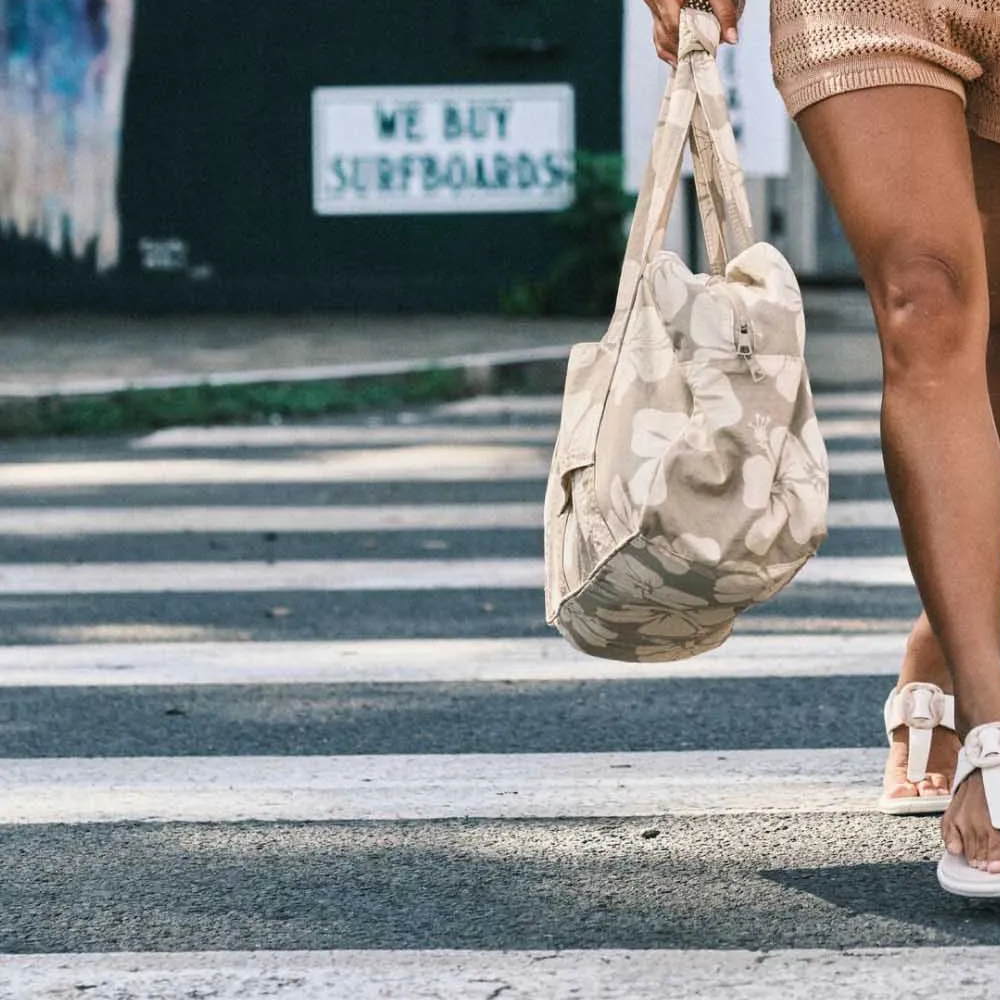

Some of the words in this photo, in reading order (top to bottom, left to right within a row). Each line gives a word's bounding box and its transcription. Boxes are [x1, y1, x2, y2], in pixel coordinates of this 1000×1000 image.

[375, 104, 420, 140] WE
[444, 104, 511, 140] BUY
[330, 152, 564, 192] SURFBOARDS
